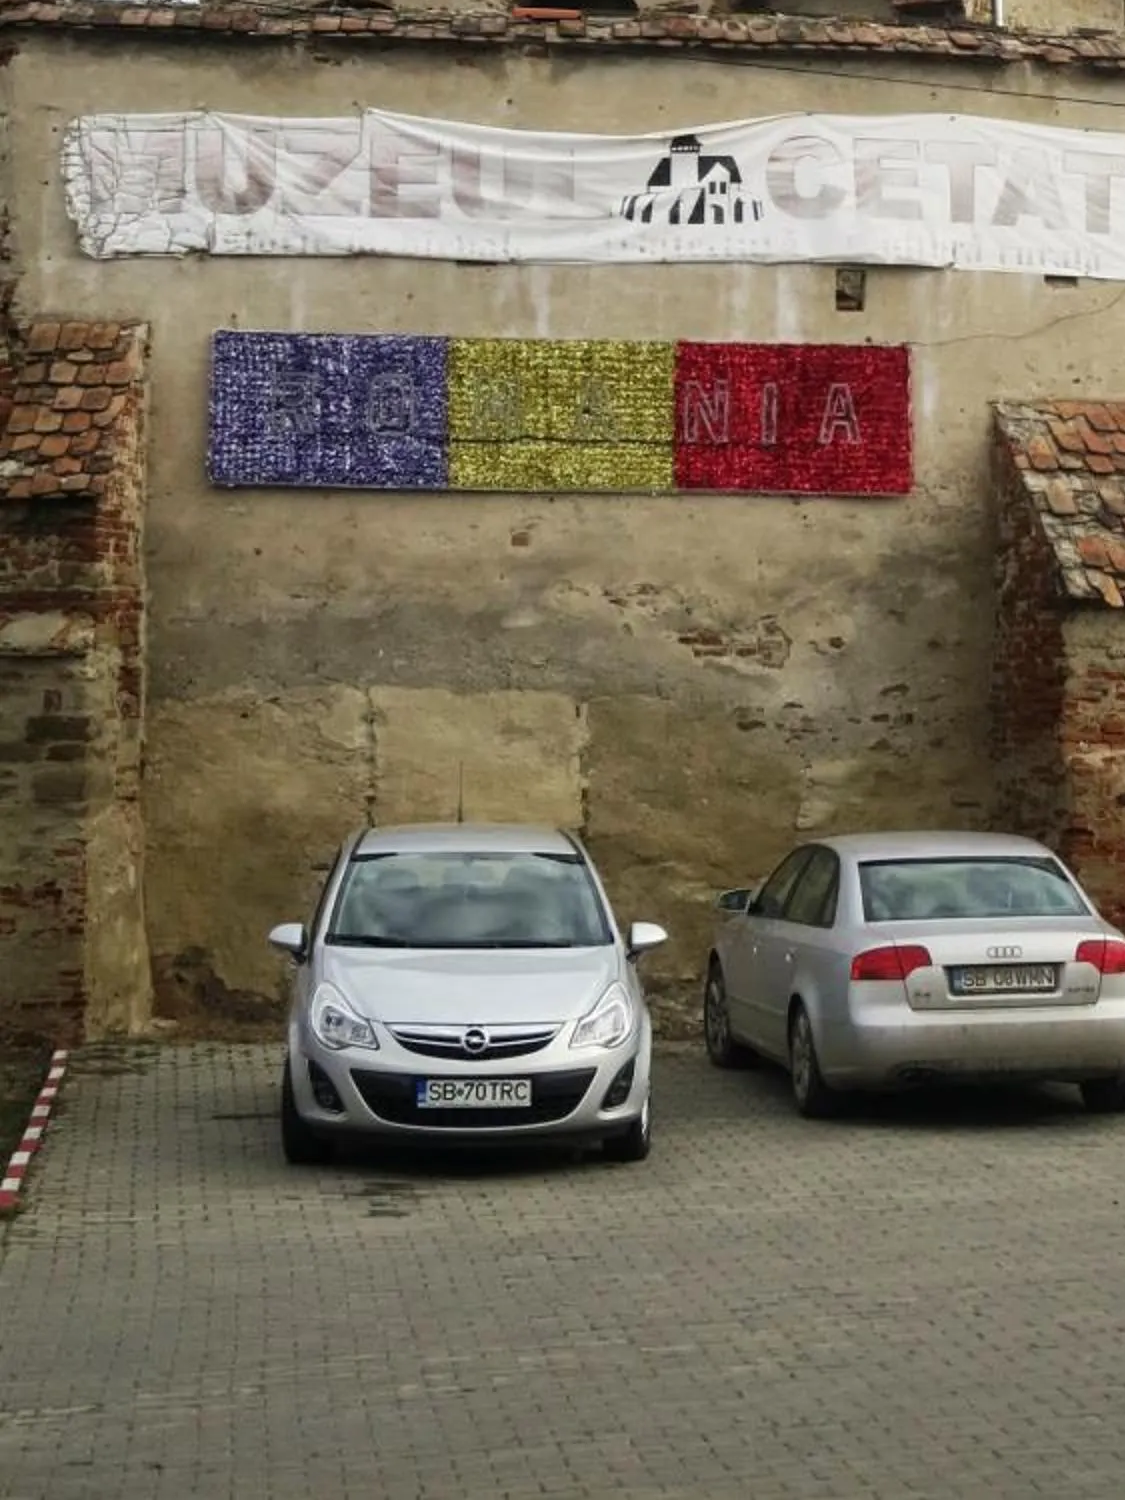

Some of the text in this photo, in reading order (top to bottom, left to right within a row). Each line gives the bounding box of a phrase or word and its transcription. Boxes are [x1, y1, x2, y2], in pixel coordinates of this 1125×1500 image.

[963, 970, 986, 986] SB
[429, 1082, 528, 1101] SB 70TRC
